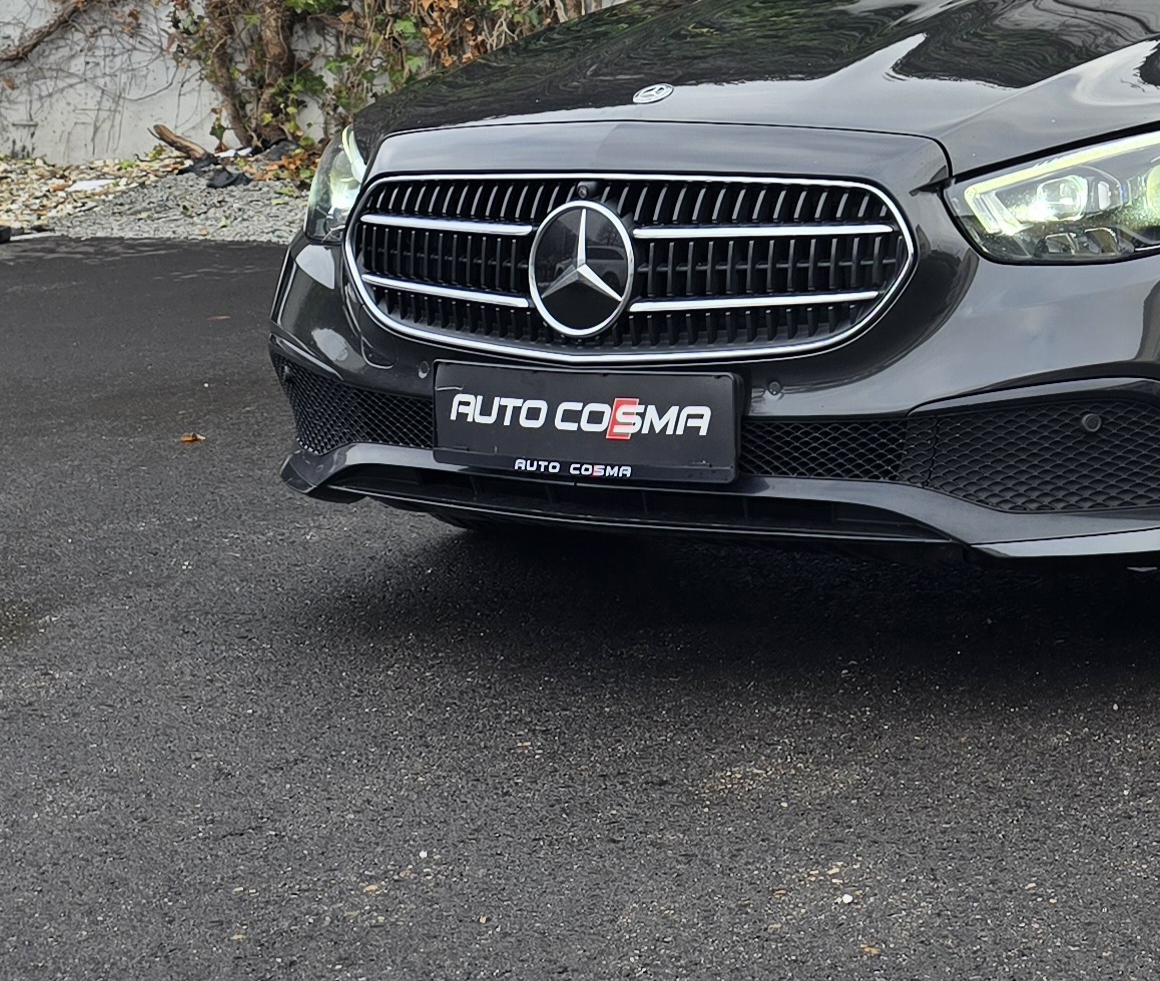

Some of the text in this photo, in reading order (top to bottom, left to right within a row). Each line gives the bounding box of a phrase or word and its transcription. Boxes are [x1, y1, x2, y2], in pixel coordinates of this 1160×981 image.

[450, 393, 712, 436] AUTO COSMA
[514, 458, 632, 478] AUTO COSMA
